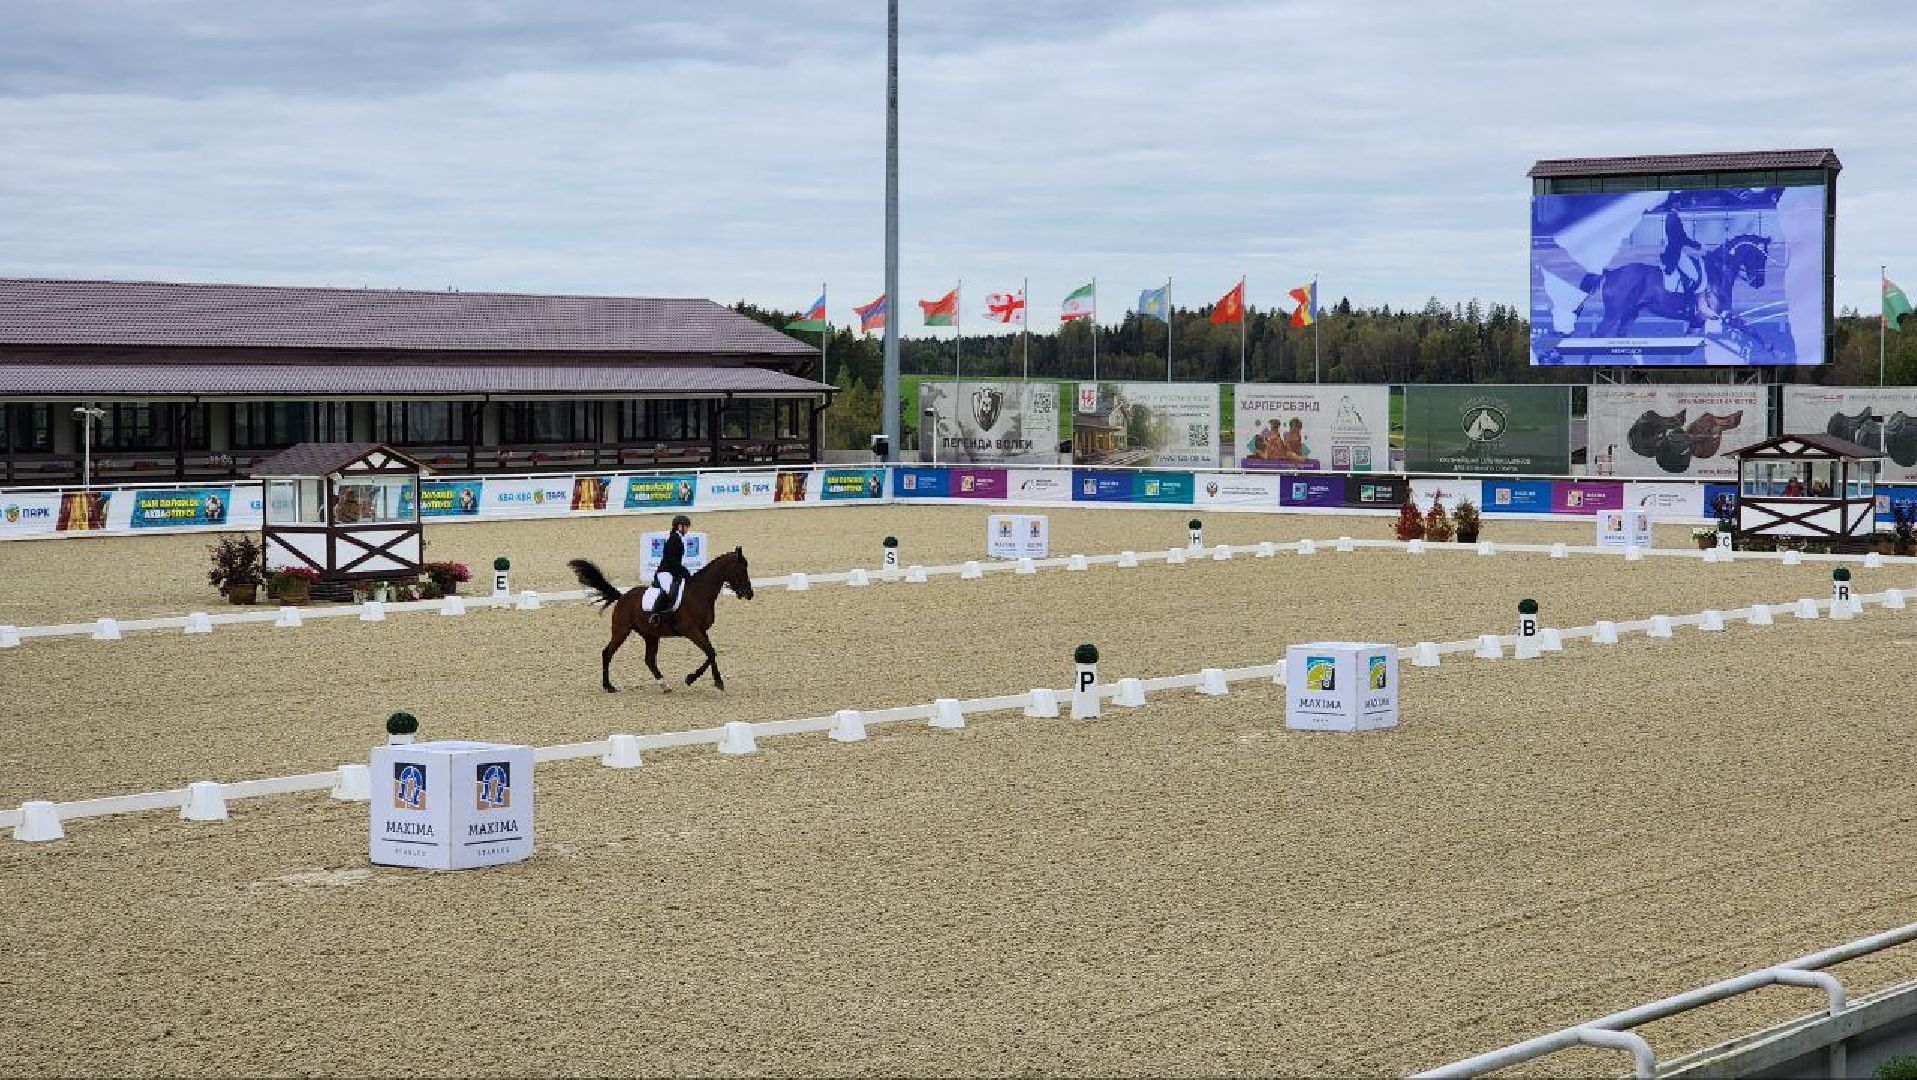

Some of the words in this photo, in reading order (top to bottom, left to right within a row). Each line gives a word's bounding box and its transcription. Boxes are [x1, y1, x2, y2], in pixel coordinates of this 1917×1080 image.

[1241, 401, 1320, 411] ХАРПЕРСБЭНД
[752, 484, 770, 492] ПАРК
[498, 491, 532, 502] КВА-КВА
[545, 490, 567, 501] ПАРК
[22, 508, 51, 519] ПАРК
[1192, 533, 1200, 544] H
[1722, 536, 1730, 547] C
[887, 552, 895, 564] S
[496, 575, 507, 590] E
[1838, 586, 1849, 600] R
[1523, 619, 1536, 636] B
[1080, 671, 1095, 693] P
[1299, 698, 1342, 709] MAXIMA
[386, 821, 434, 837] MAXIMA
[468, 819, 518, 836] MAXIMA
